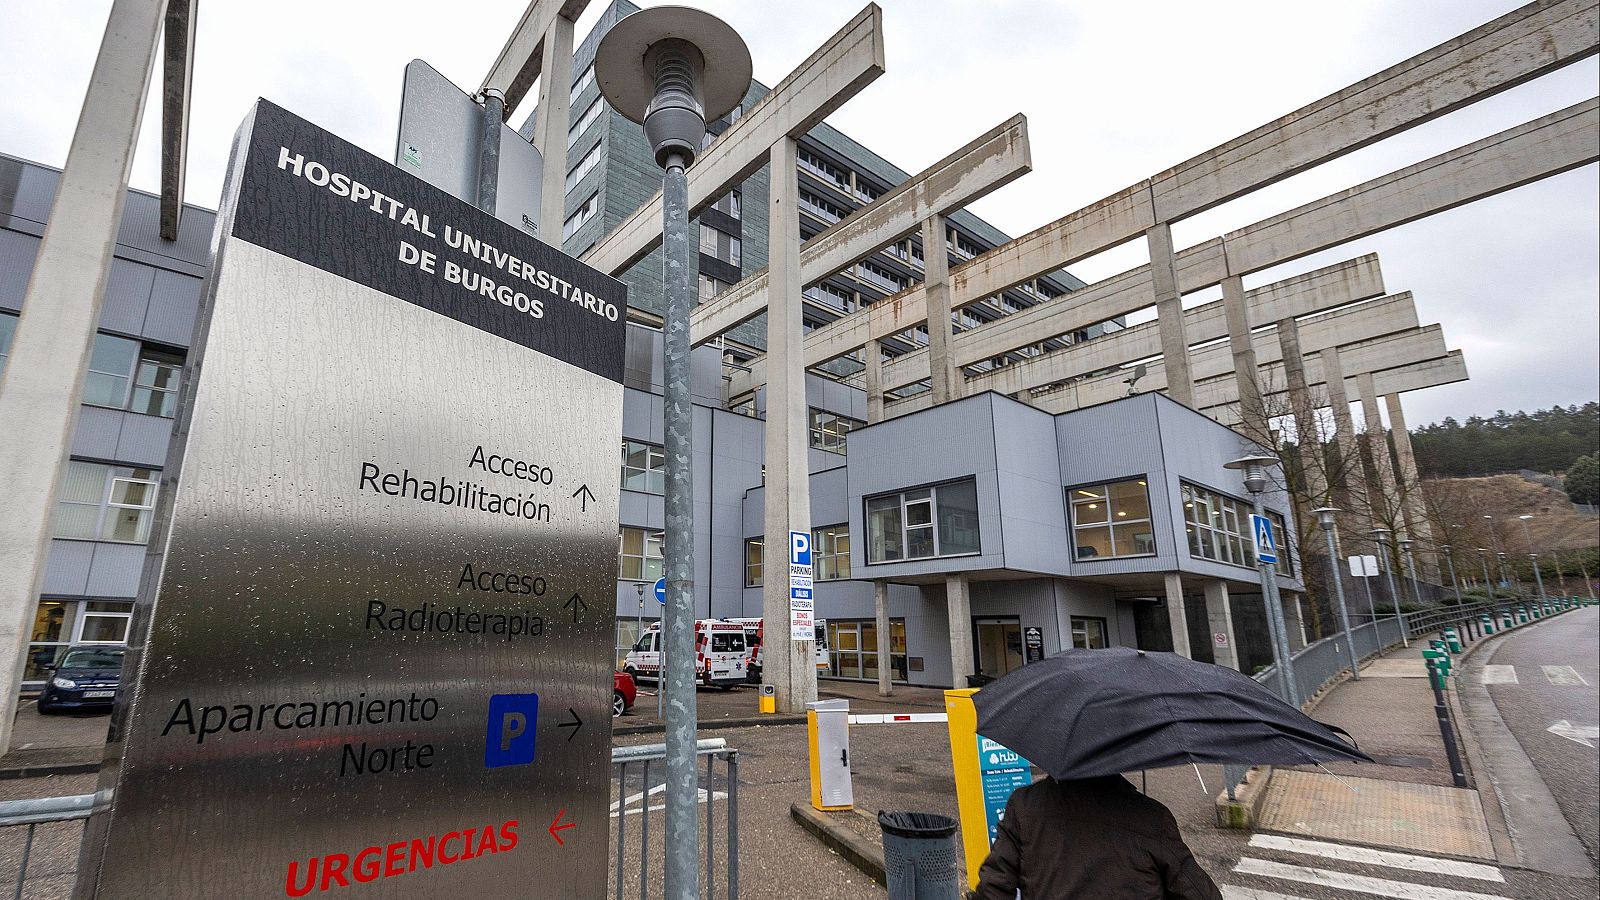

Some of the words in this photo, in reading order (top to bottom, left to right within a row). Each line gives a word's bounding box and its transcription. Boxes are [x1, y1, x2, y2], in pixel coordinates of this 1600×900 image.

[277, 146, 436, 239] HOSPITAL
[444, 224, 619, 322] UNIVERSITARIO
[398, 240, 437, 275] DE
[444, 260, 544, 319] BURGOS
[468, 445, 553, 485] Acceso
[359, 461, 550, 522] Rehabilitación
[793, 533, 808, 563] P
[457, 563, 547, 596] Acceso
[791, 566, 811, 576] PARKING
[365, 600, 544, 642] Radioterapia
[161, 692, 439, 744] Aparcamiento
[501, 712, 526, 750] P
[339, 740, 434, 777] Norte
[285, 820, 519, 898] URGENCIAS
